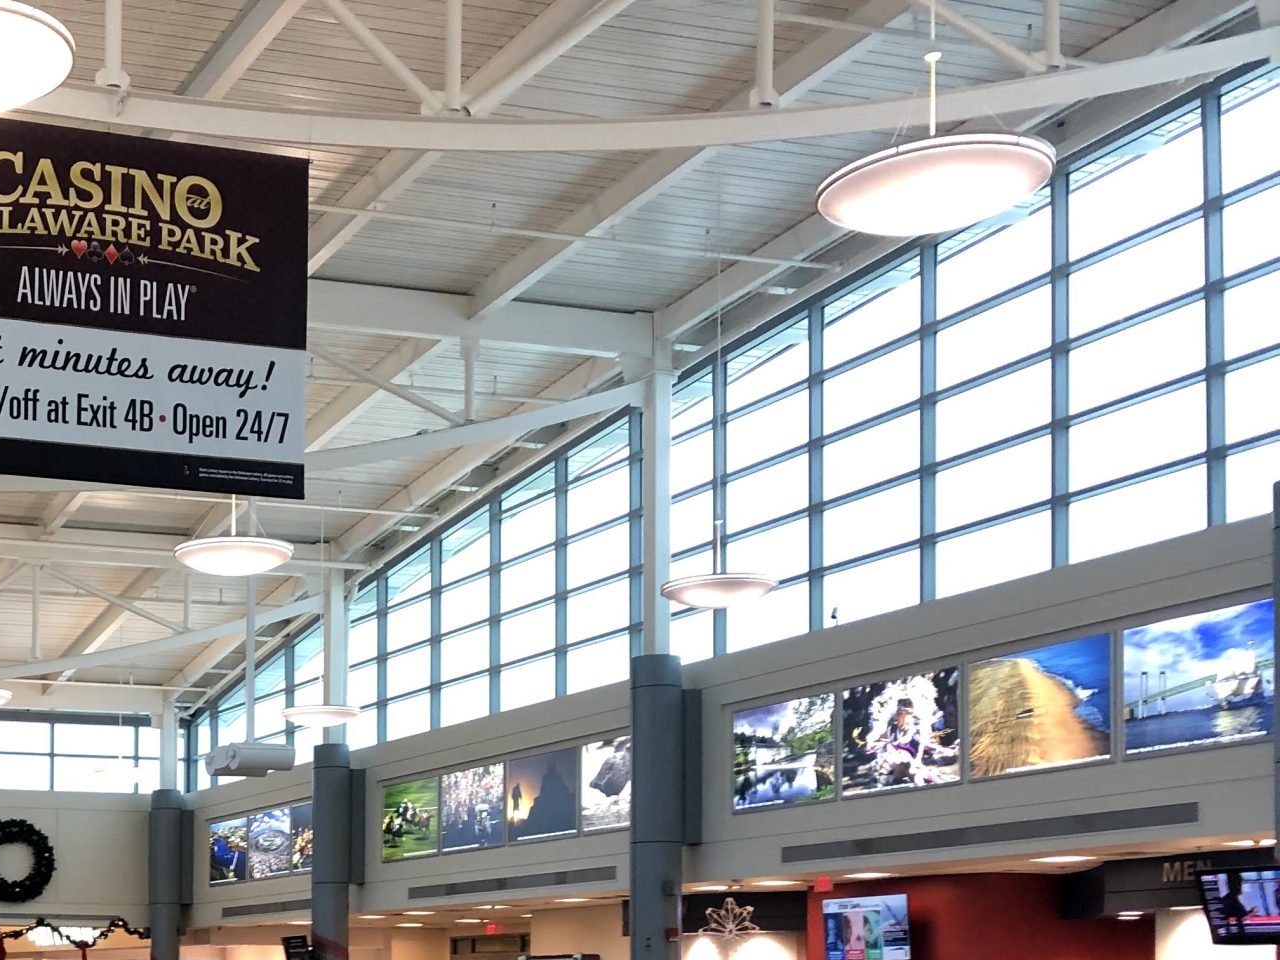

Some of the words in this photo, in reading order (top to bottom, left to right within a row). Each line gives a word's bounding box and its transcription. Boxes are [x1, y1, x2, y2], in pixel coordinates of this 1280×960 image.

[157, 222, 261, 273] PARK
[17, 265, 101, 312] ALWAYS
[109, 275, 131, 315] IN
[140, 280, 190, 321] PLAY
[18, 338, 154, 380] minutes
[168, 360, 276, 398] away!
[47, 395, 69, 424] at
[76, 393, 117, 429] Exit
[124, 398, 154, 433] 4B
[172, 402, 228, 444] Open
[235, 409, 290, 445] 24/7
